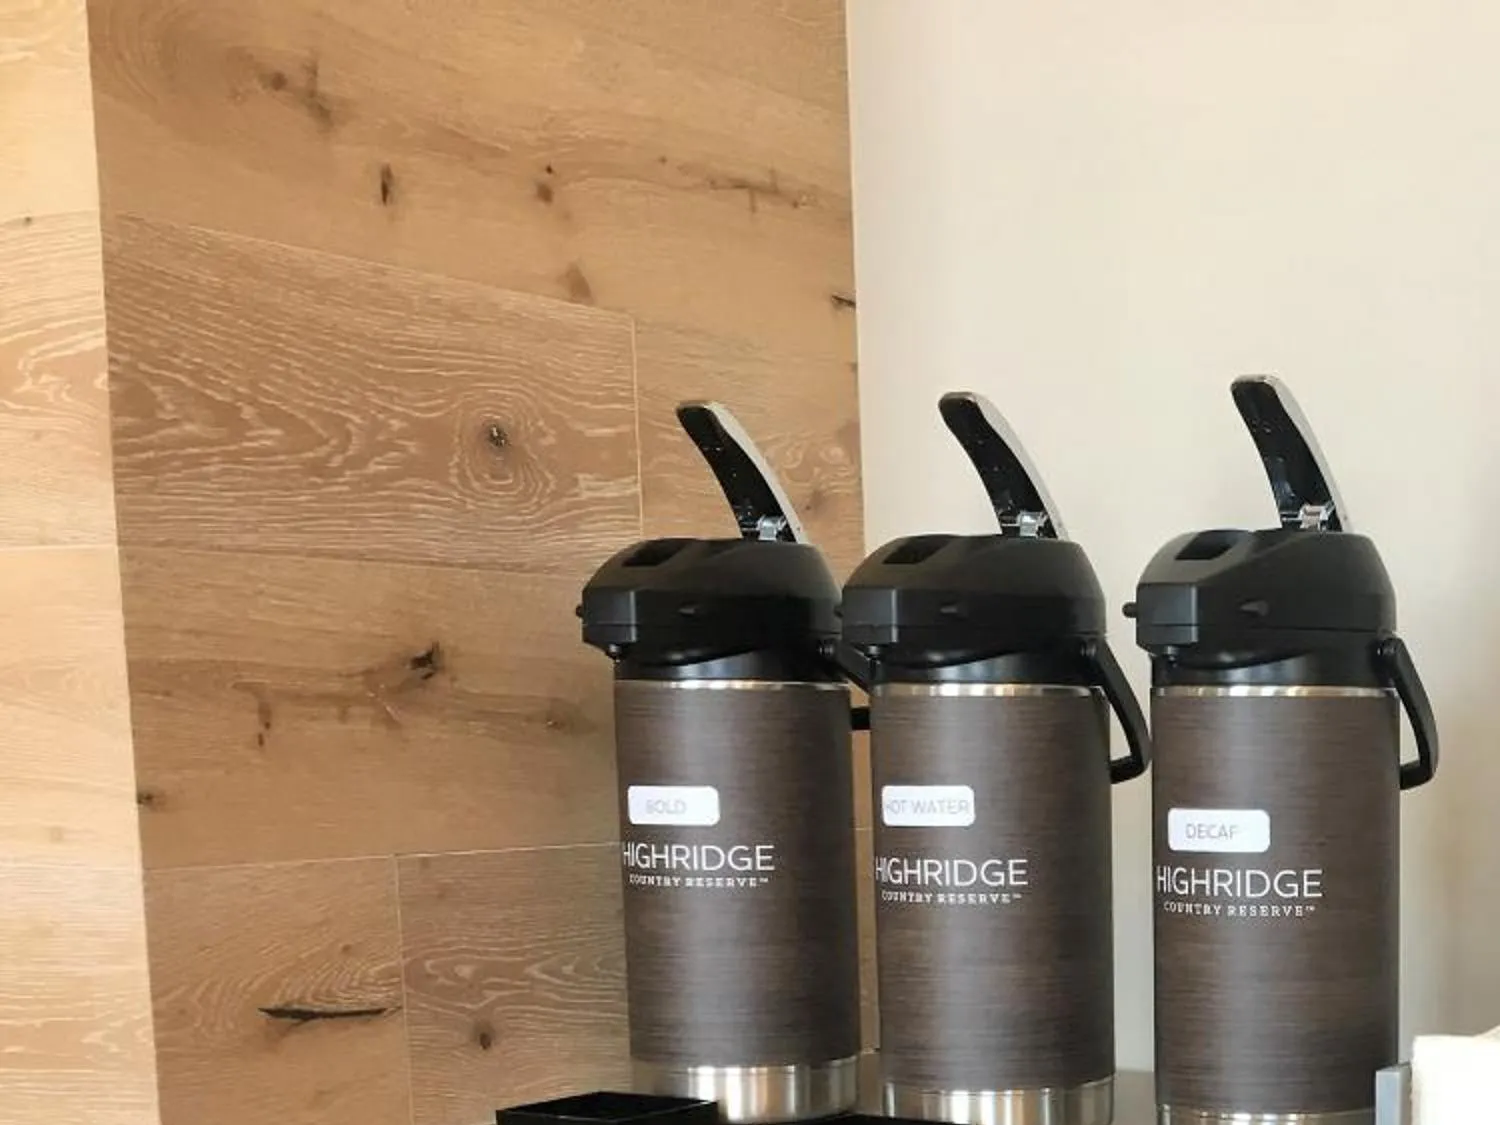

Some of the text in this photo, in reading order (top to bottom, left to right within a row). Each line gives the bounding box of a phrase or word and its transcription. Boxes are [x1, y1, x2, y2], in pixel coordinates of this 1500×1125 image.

[646, 798, 687, 815] BOLD
[911, 798, 970, 815] WATER
[1184, 822, 1241, 840] DECAF
[623, 841, 776, 871] HIGHRIDGE
[875, 856, 1029, 887] HIGHRIDGE
[629, 873, 681, 888] COUNTRY
[1155, 865, 1324, 898] HIGHRIDGE
[881, 890, 933, 905] COUNTRY
[1163, 900, 1221, 917] COUNTRY
